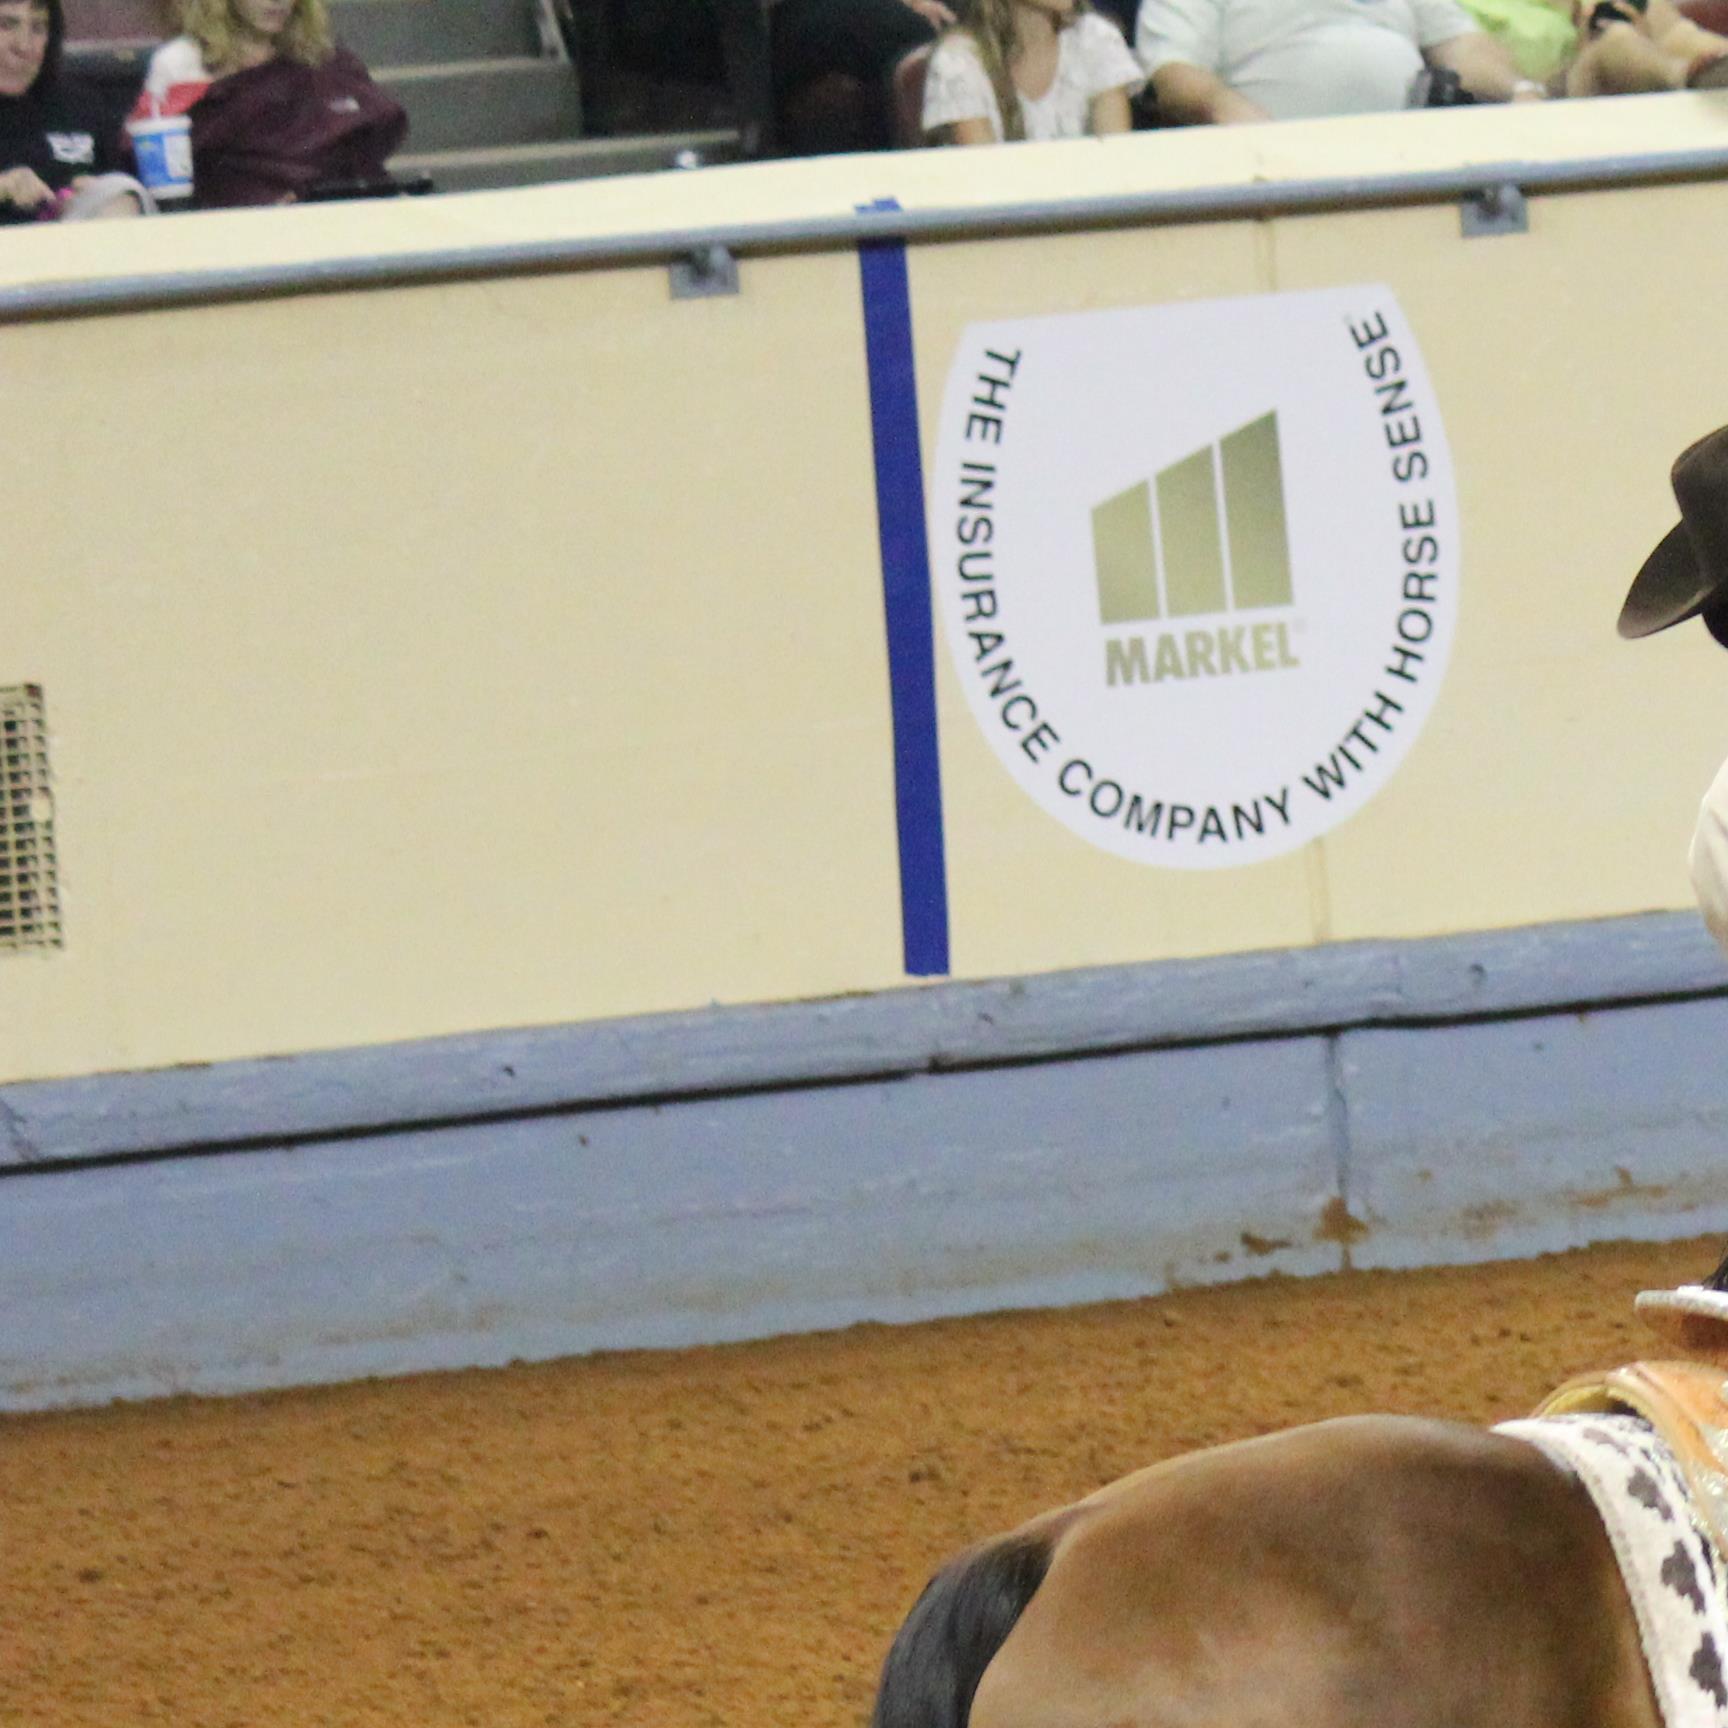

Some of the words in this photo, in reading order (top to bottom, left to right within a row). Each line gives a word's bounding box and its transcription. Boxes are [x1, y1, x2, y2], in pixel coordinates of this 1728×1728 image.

[964, 347, 1022, 445] THE
[1349, 311, 1429, 484] SENSE
[956, 462, 1061, 763] INSURANCE
[1386, 498, 1439, 683] HORSE
[1104, 621, 1300, 687] MARKEL
[1058, 758, 1292, 844] COMPANY
[1301, 697, 1405, 802] WITH
